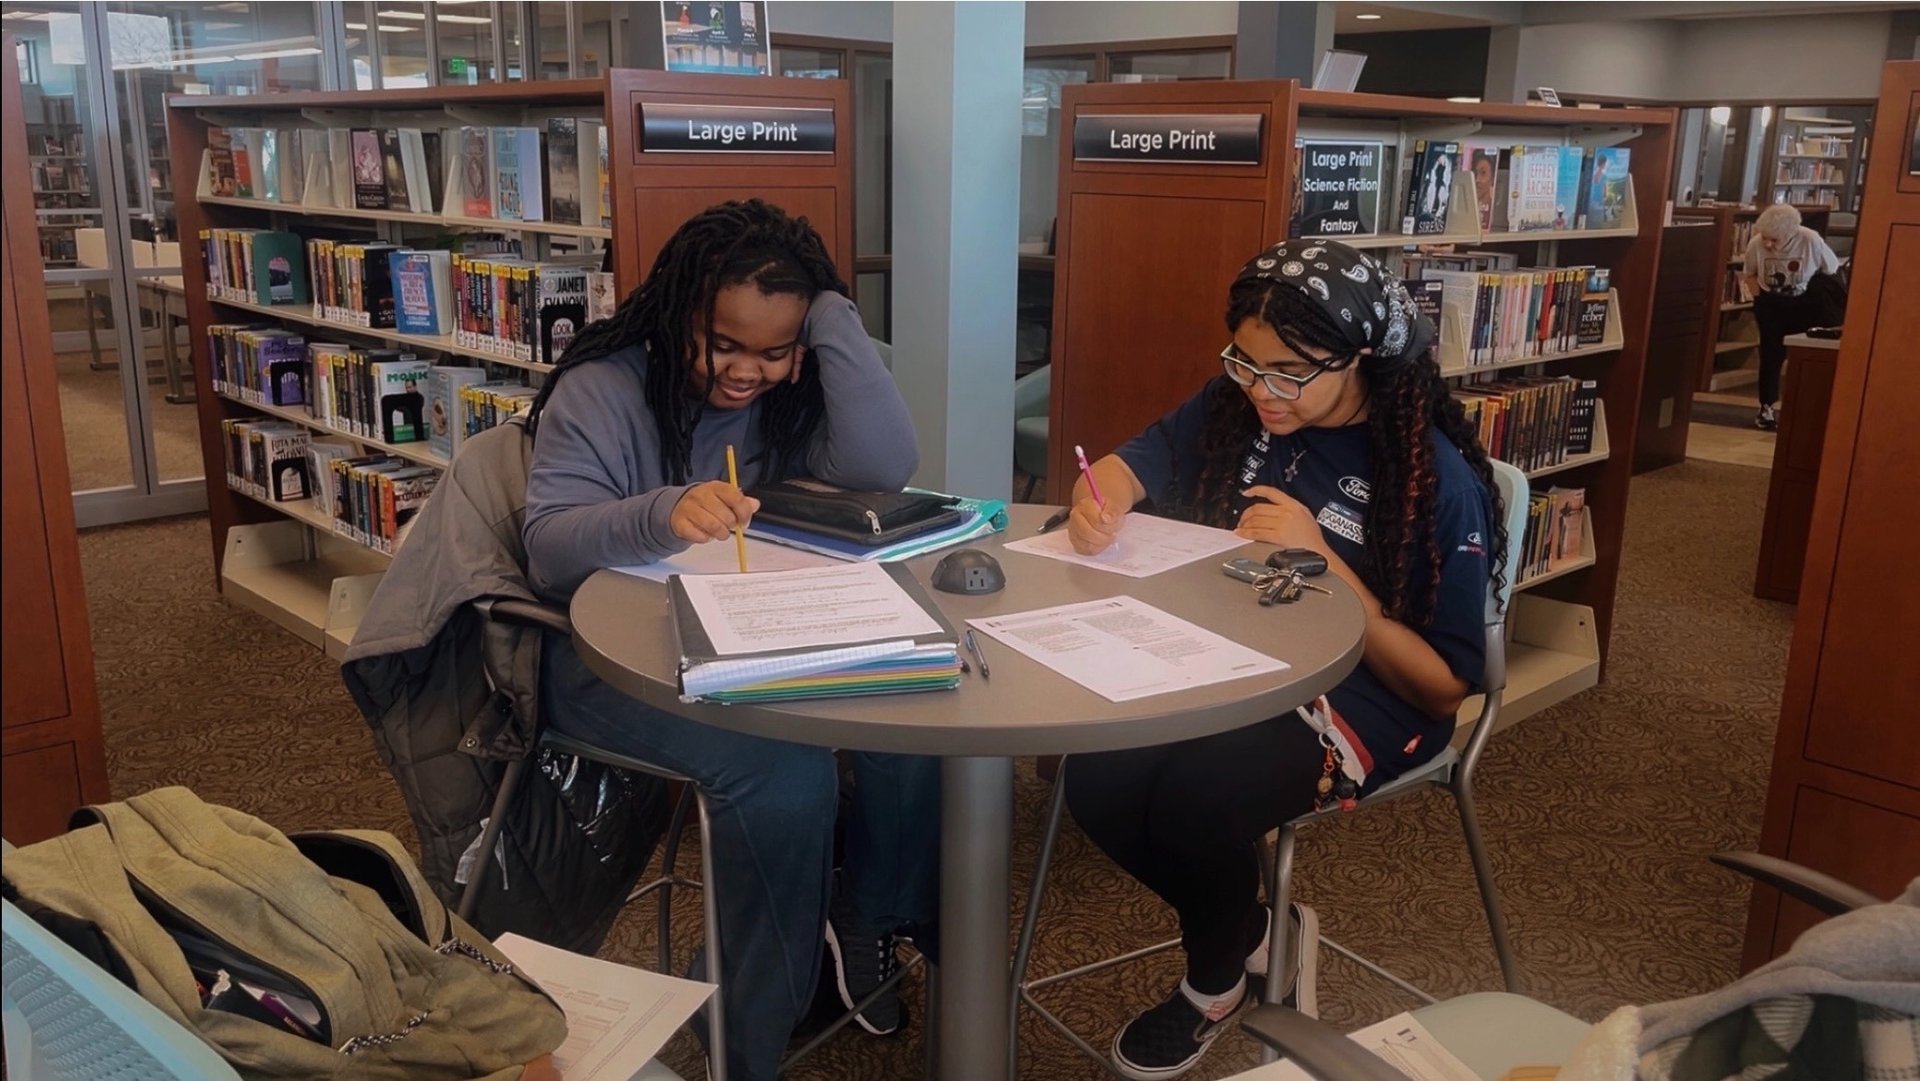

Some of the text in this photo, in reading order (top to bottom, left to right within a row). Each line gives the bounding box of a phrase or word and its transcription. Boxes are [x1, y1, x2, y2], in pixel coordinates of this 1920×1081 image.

[688, 120, 798, 144] Large Print
[1110, 129, 1216, 152] Large Print
[1312, 150, 1373, 169] Large Print
[1304, 178, 1378, 192] Science Fiction
[1333, 200, 1349, 211] And
[1320, 218, 1358, 234] Fantasy
[1417, 219, 1445, 233] SIRENS
[556, 276, 586, 293] JANET
[544, 296, 588, 306] EVANOVI
[1581, 311, 1604, 322] rcher
[553, 323, 572, 335] LOOK
[386, 372, 429, 382] MONK
